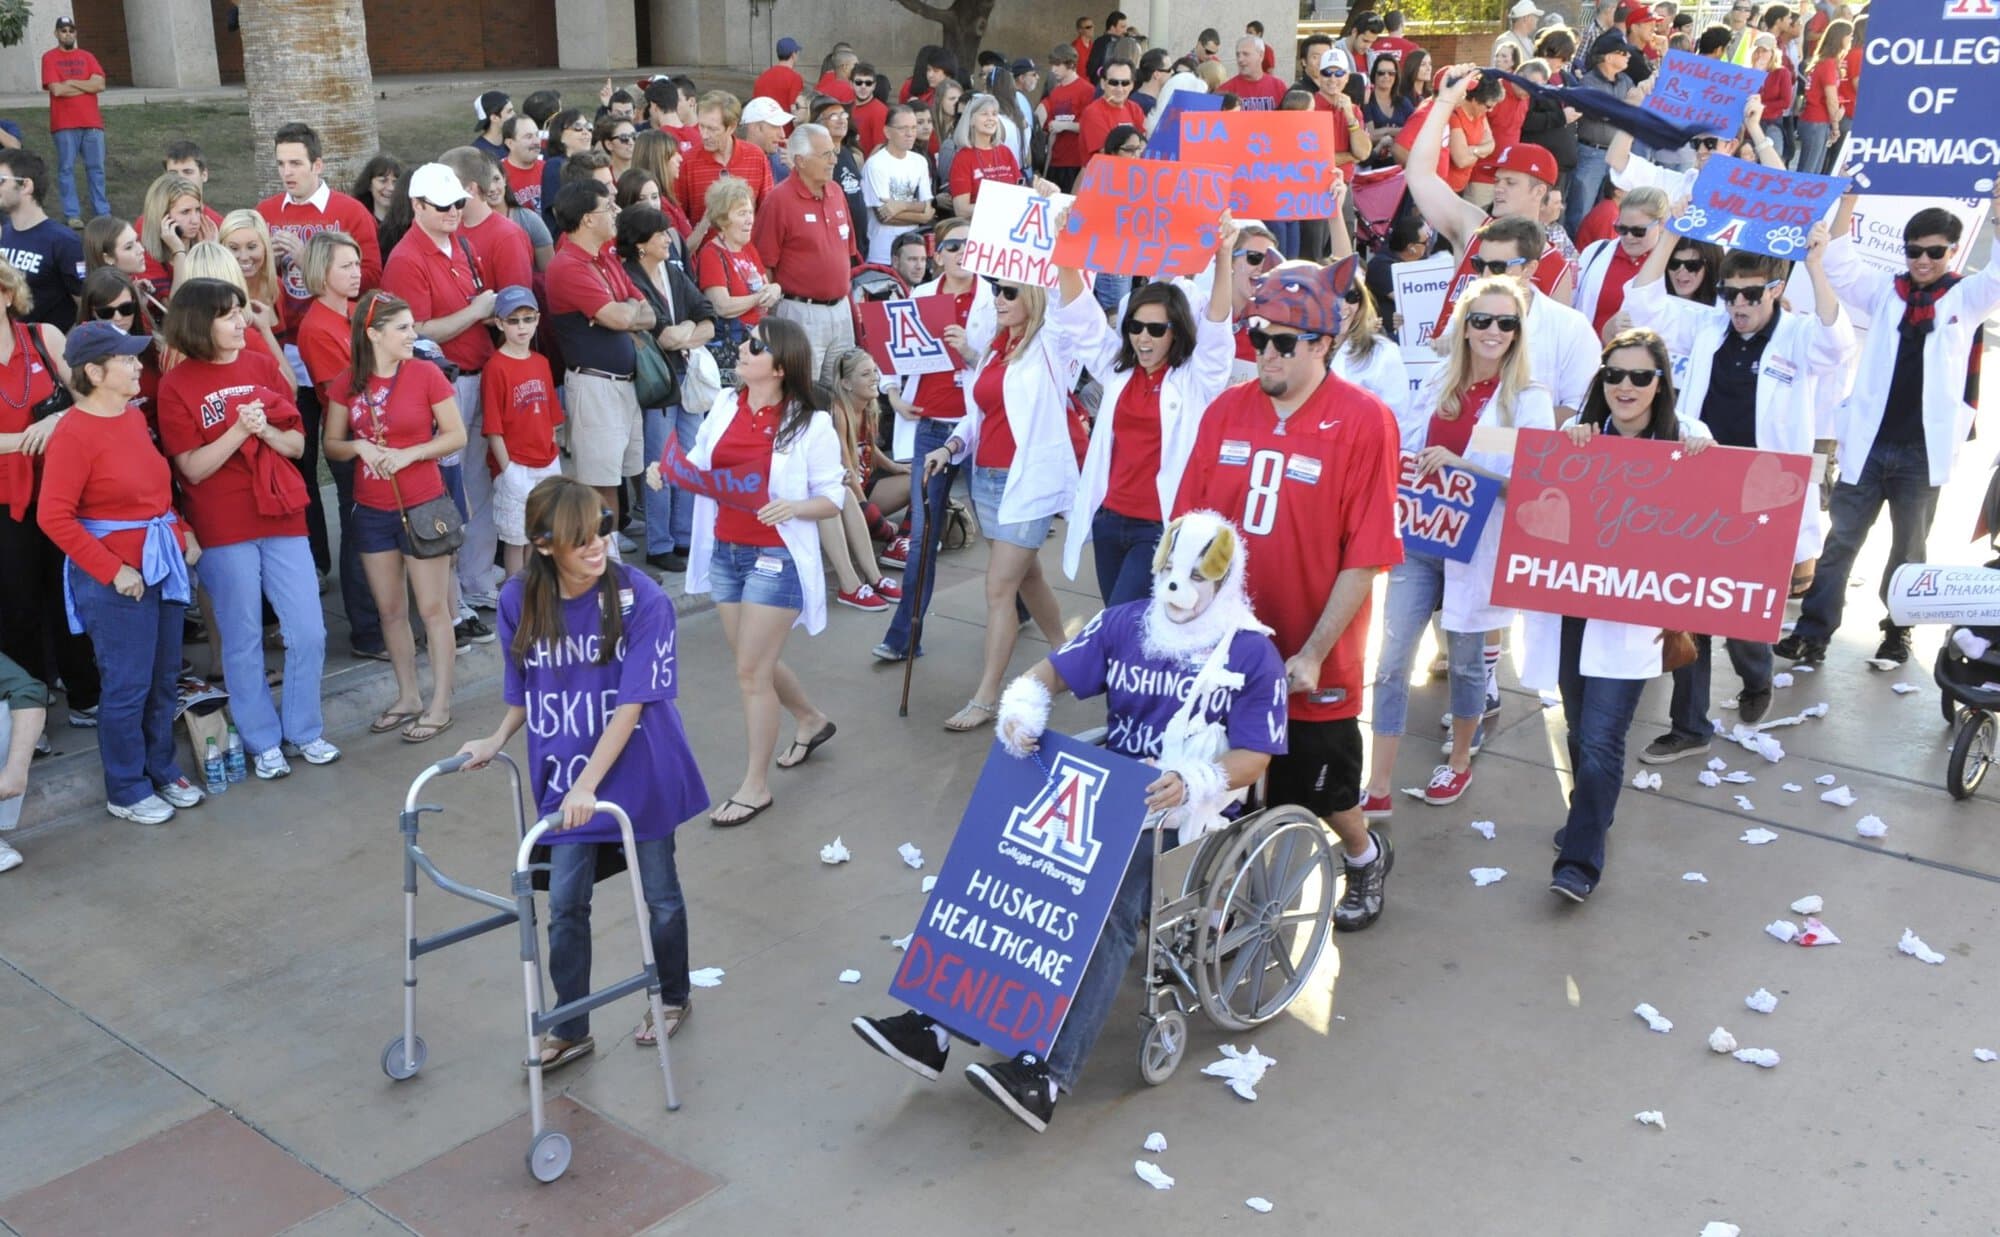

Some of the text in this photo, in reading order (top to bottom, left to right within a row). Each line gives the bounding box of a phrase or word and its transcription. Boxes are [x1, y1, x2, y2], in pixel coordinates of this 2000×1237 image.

[1667, 58, 1755, 92] Wildcats
[1702, 84, 1736, 105] for
[1907, 86, 1958, 115] OF
[1648, 96, 1730, 130] Huskitis
[1184, 119, 1229, 143] UA
[1846, 136, 2000, 166] PHARMACY
[1080, 160, 1233, 212] WILDCATS
[1231, 159, 1330, 184] ARMACY
[1727, 166, 1829, 200] LET'S GO
[1274, 190, 1336, 218] 2010
[1708, 190, 1818, 226] WILDCATS
[1009, 195, 1053, 251] A
[1115, 205, 1175, 244] FOR
[1707, 217, 1747, 247] A
[1084, 234, 1193, 279] LIFE
[883, 298, 943, 360] A
[200, 398, 226, 429] AR
[1520, 435, 1673, 488] Love
[712, 471, 762, 494] The
[1243, 449, 1285, 536] 8
[1589, 485, 1758, 549] Your
[1505, 553, 1777, 620] PHARMACIST!
[1906, 569, 1942, 598] A
[655, 629, 675, 659] W
[651, 656, 675, 690] 15
[1002, 751, 1111, 875] A
[997, 840, 1034, 867] College
[965, 868, 1079, 943] HUSKIES
[928, 898, 1073, 987] HEALTHCARE
[896, 935, 1070, 1051] DENIED!
